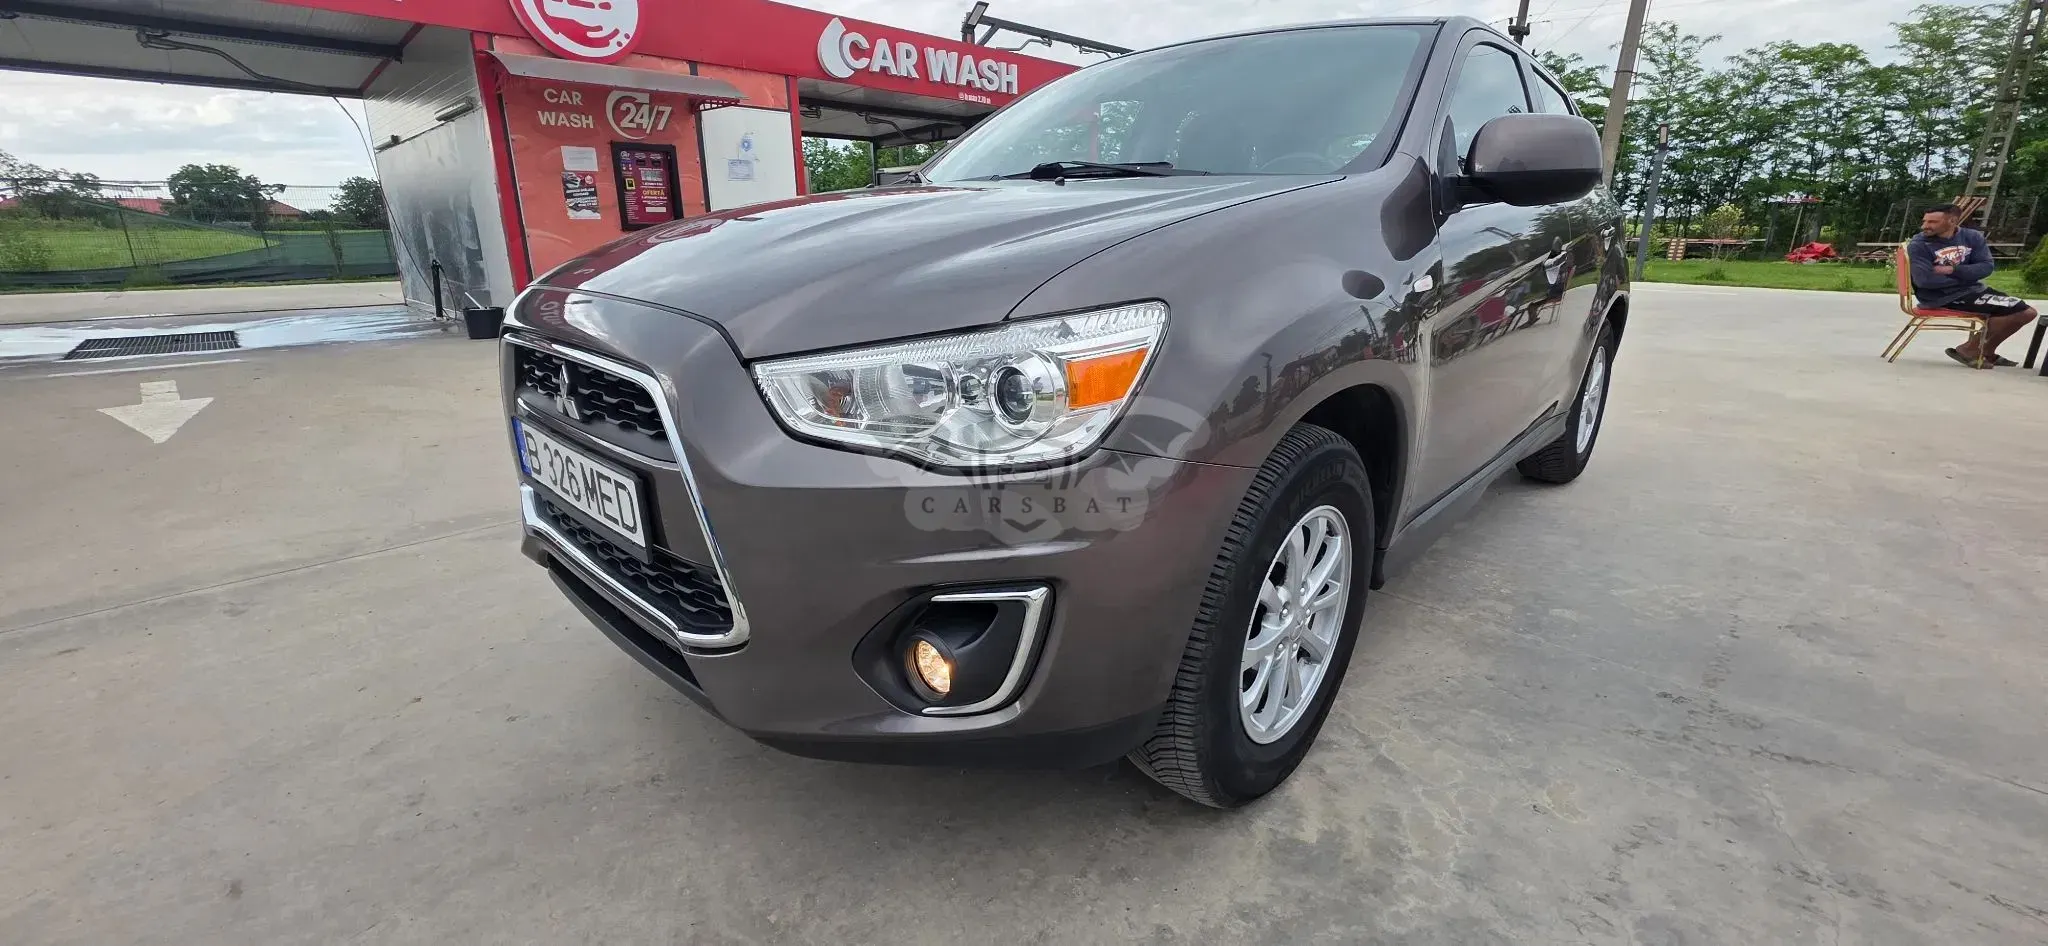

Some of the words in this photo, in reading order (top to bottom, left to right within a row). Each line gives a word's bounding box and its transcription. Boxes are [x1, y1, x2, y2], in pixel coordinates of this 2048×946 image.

[839, 31, 920, 79] CAR
[924, 46, 1018, 95] WASH
[543, 88, 583, 106] CAR
[537, 110, 594, 129] WASH
[619, 102, 672, 134] 24/7
[524, 430, 542, 476] B
[543, 442, 581, 503] 326
[580, 462, 638, 534] MED
